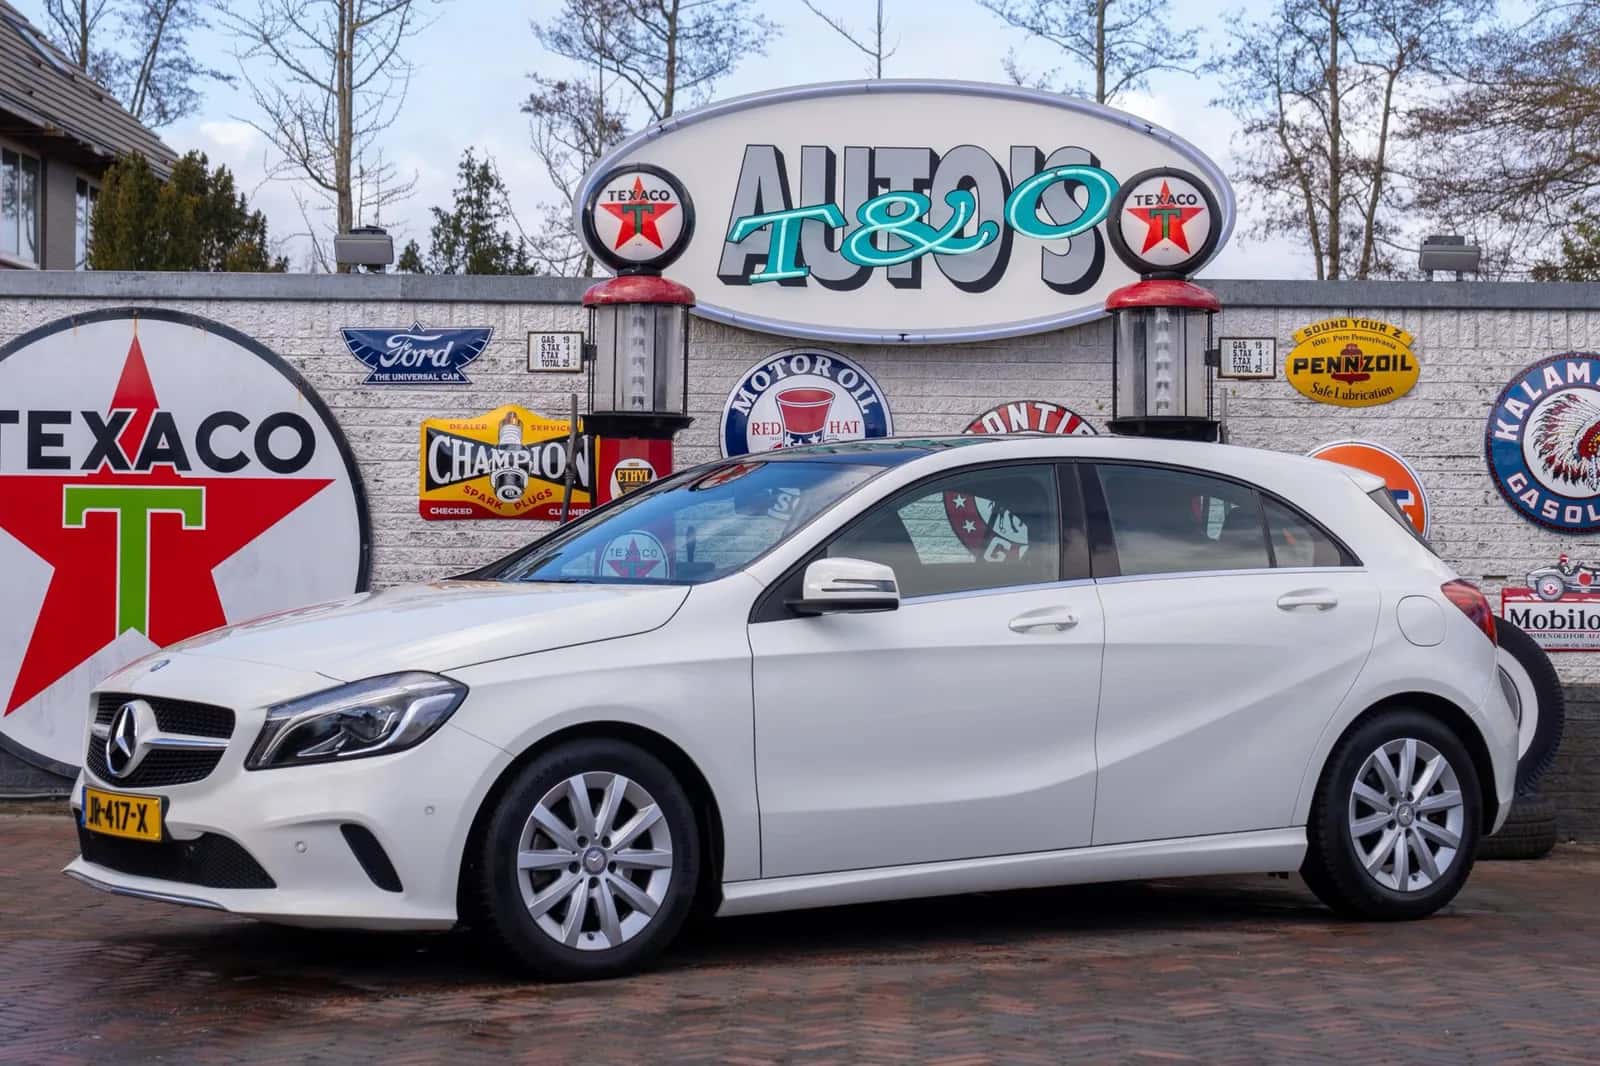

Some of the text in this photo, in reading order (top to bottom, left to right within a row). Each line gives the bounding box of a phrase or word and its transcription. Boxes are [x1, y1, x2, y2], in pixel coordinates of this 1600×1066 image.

[608, 190, 670, 201] TEXACO
[1134, 193, 1198, 206] TEXACO
[622, 204, 655, 234] T
[717, 144, 1105, 295] AUTO'S
[1149, 208, 1182, 239] T
[1304, 319, 1403, 338] SOUND YOUR Z
[541, 335, 555, 343] GAS
[1232, 341, 1247, 349] GAS
[380, 334, 454, 367] Ford
[562, 359, 570, 367] 25
[1233, 365, 1262, 373] TOTAL 25
[1293, 354, 1413, 375] PENNZOIL
[374, 373, 460, 381] THE UNIVERSAL CAR
[732, 355, 878, 416] MOTOR OIL
[1311, 382, 1394, 400] Safe Lubrication
[1494, 362, 1600, 441] KALAM
[450, 423, 571, 432] DEALER SERVIC
[752, 421, 860, 435] RED HAT
[428, 434, 590, 487] CHAMPION
[617, 469, 650, 482] ETHYL
[463, 484, 553, 511] SPARK PLUGS
[1506, 472, 1600, 524] GASOL
[430, 507, 591, 516] CHECKED CLANE
[610, 547, 658, 558] TEXCO
[64, 486, 205, 638] T
[89, 796, 148, 833] JR-417-X
